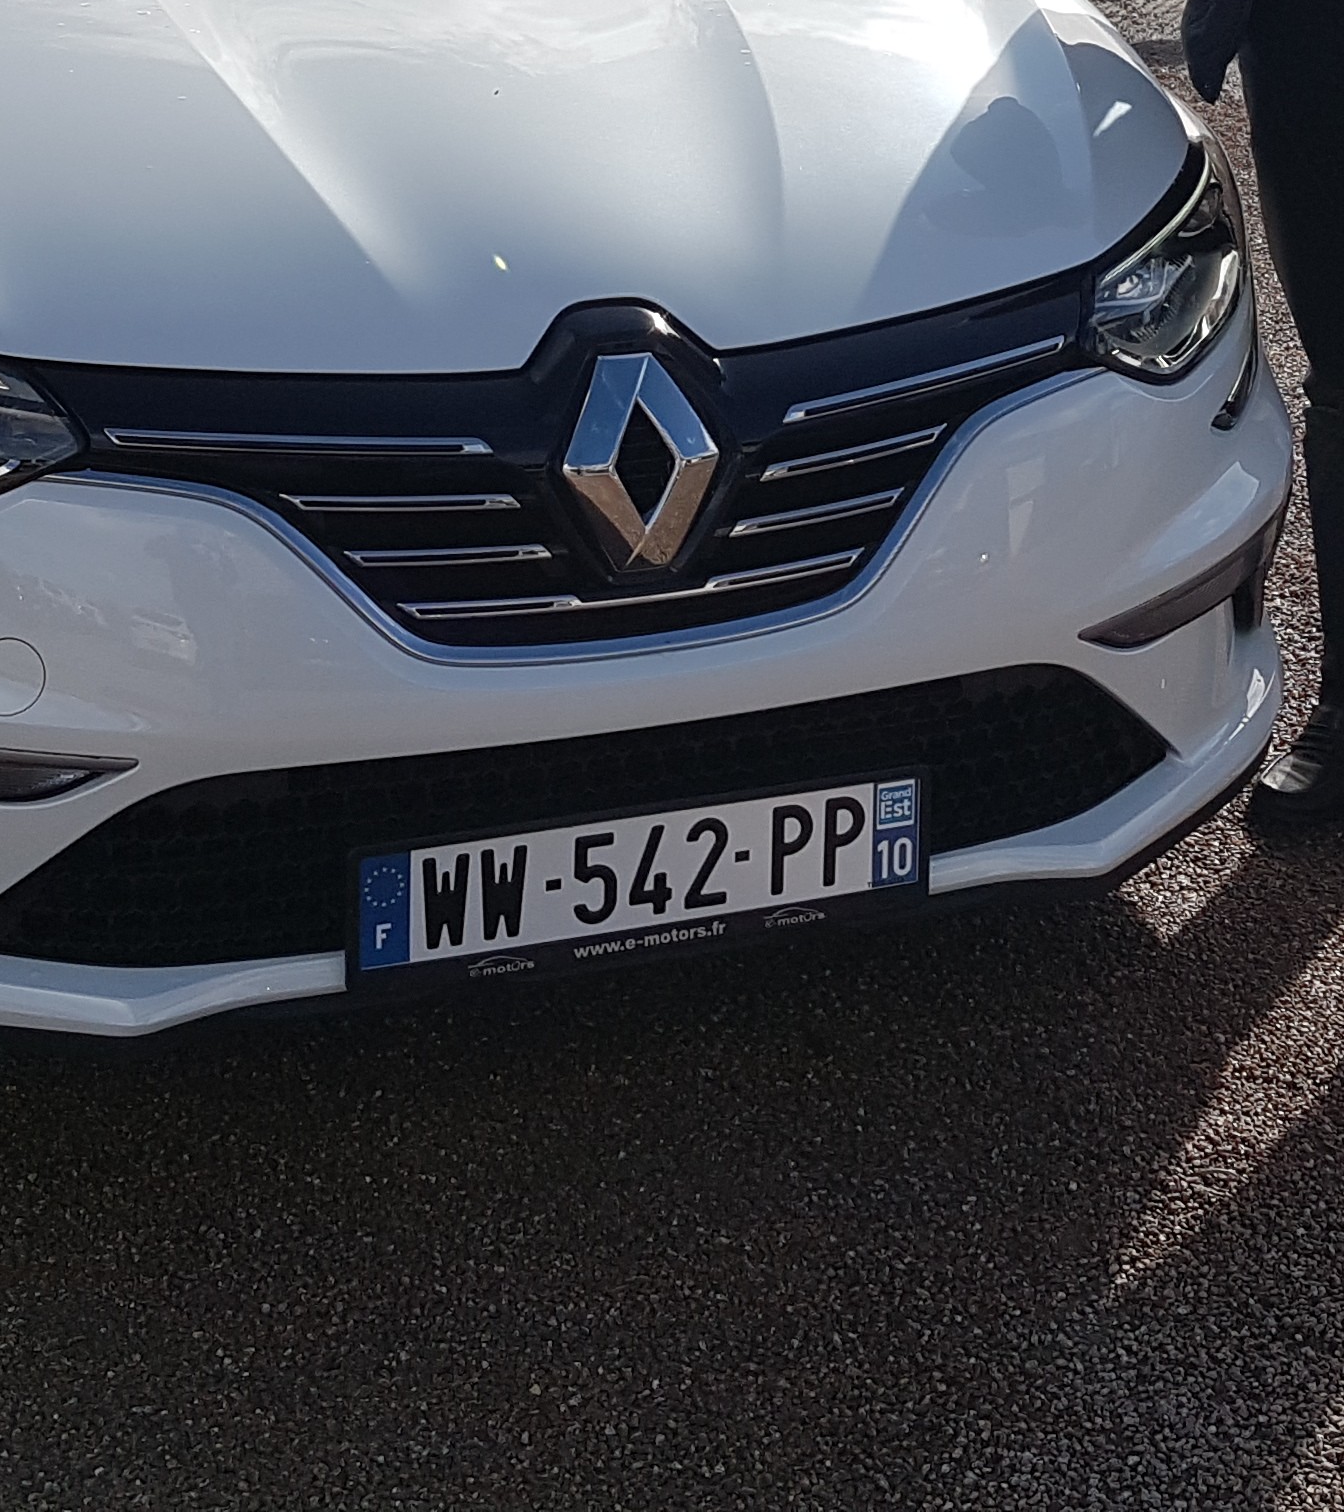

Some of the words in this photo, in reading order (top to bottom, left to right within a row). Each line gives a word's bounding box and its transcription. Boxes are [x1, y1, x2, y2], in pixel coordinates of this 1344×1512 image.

[880, 787, 912, 801] Grand
[880, 798, 911, 820] Est
[422, 796, 866, 950] WW-542-PP
[876, 836, 913, 879] 10
[375, 923, 392, 949] F
[573, 920, 727, 959] www.e-motors.fr
